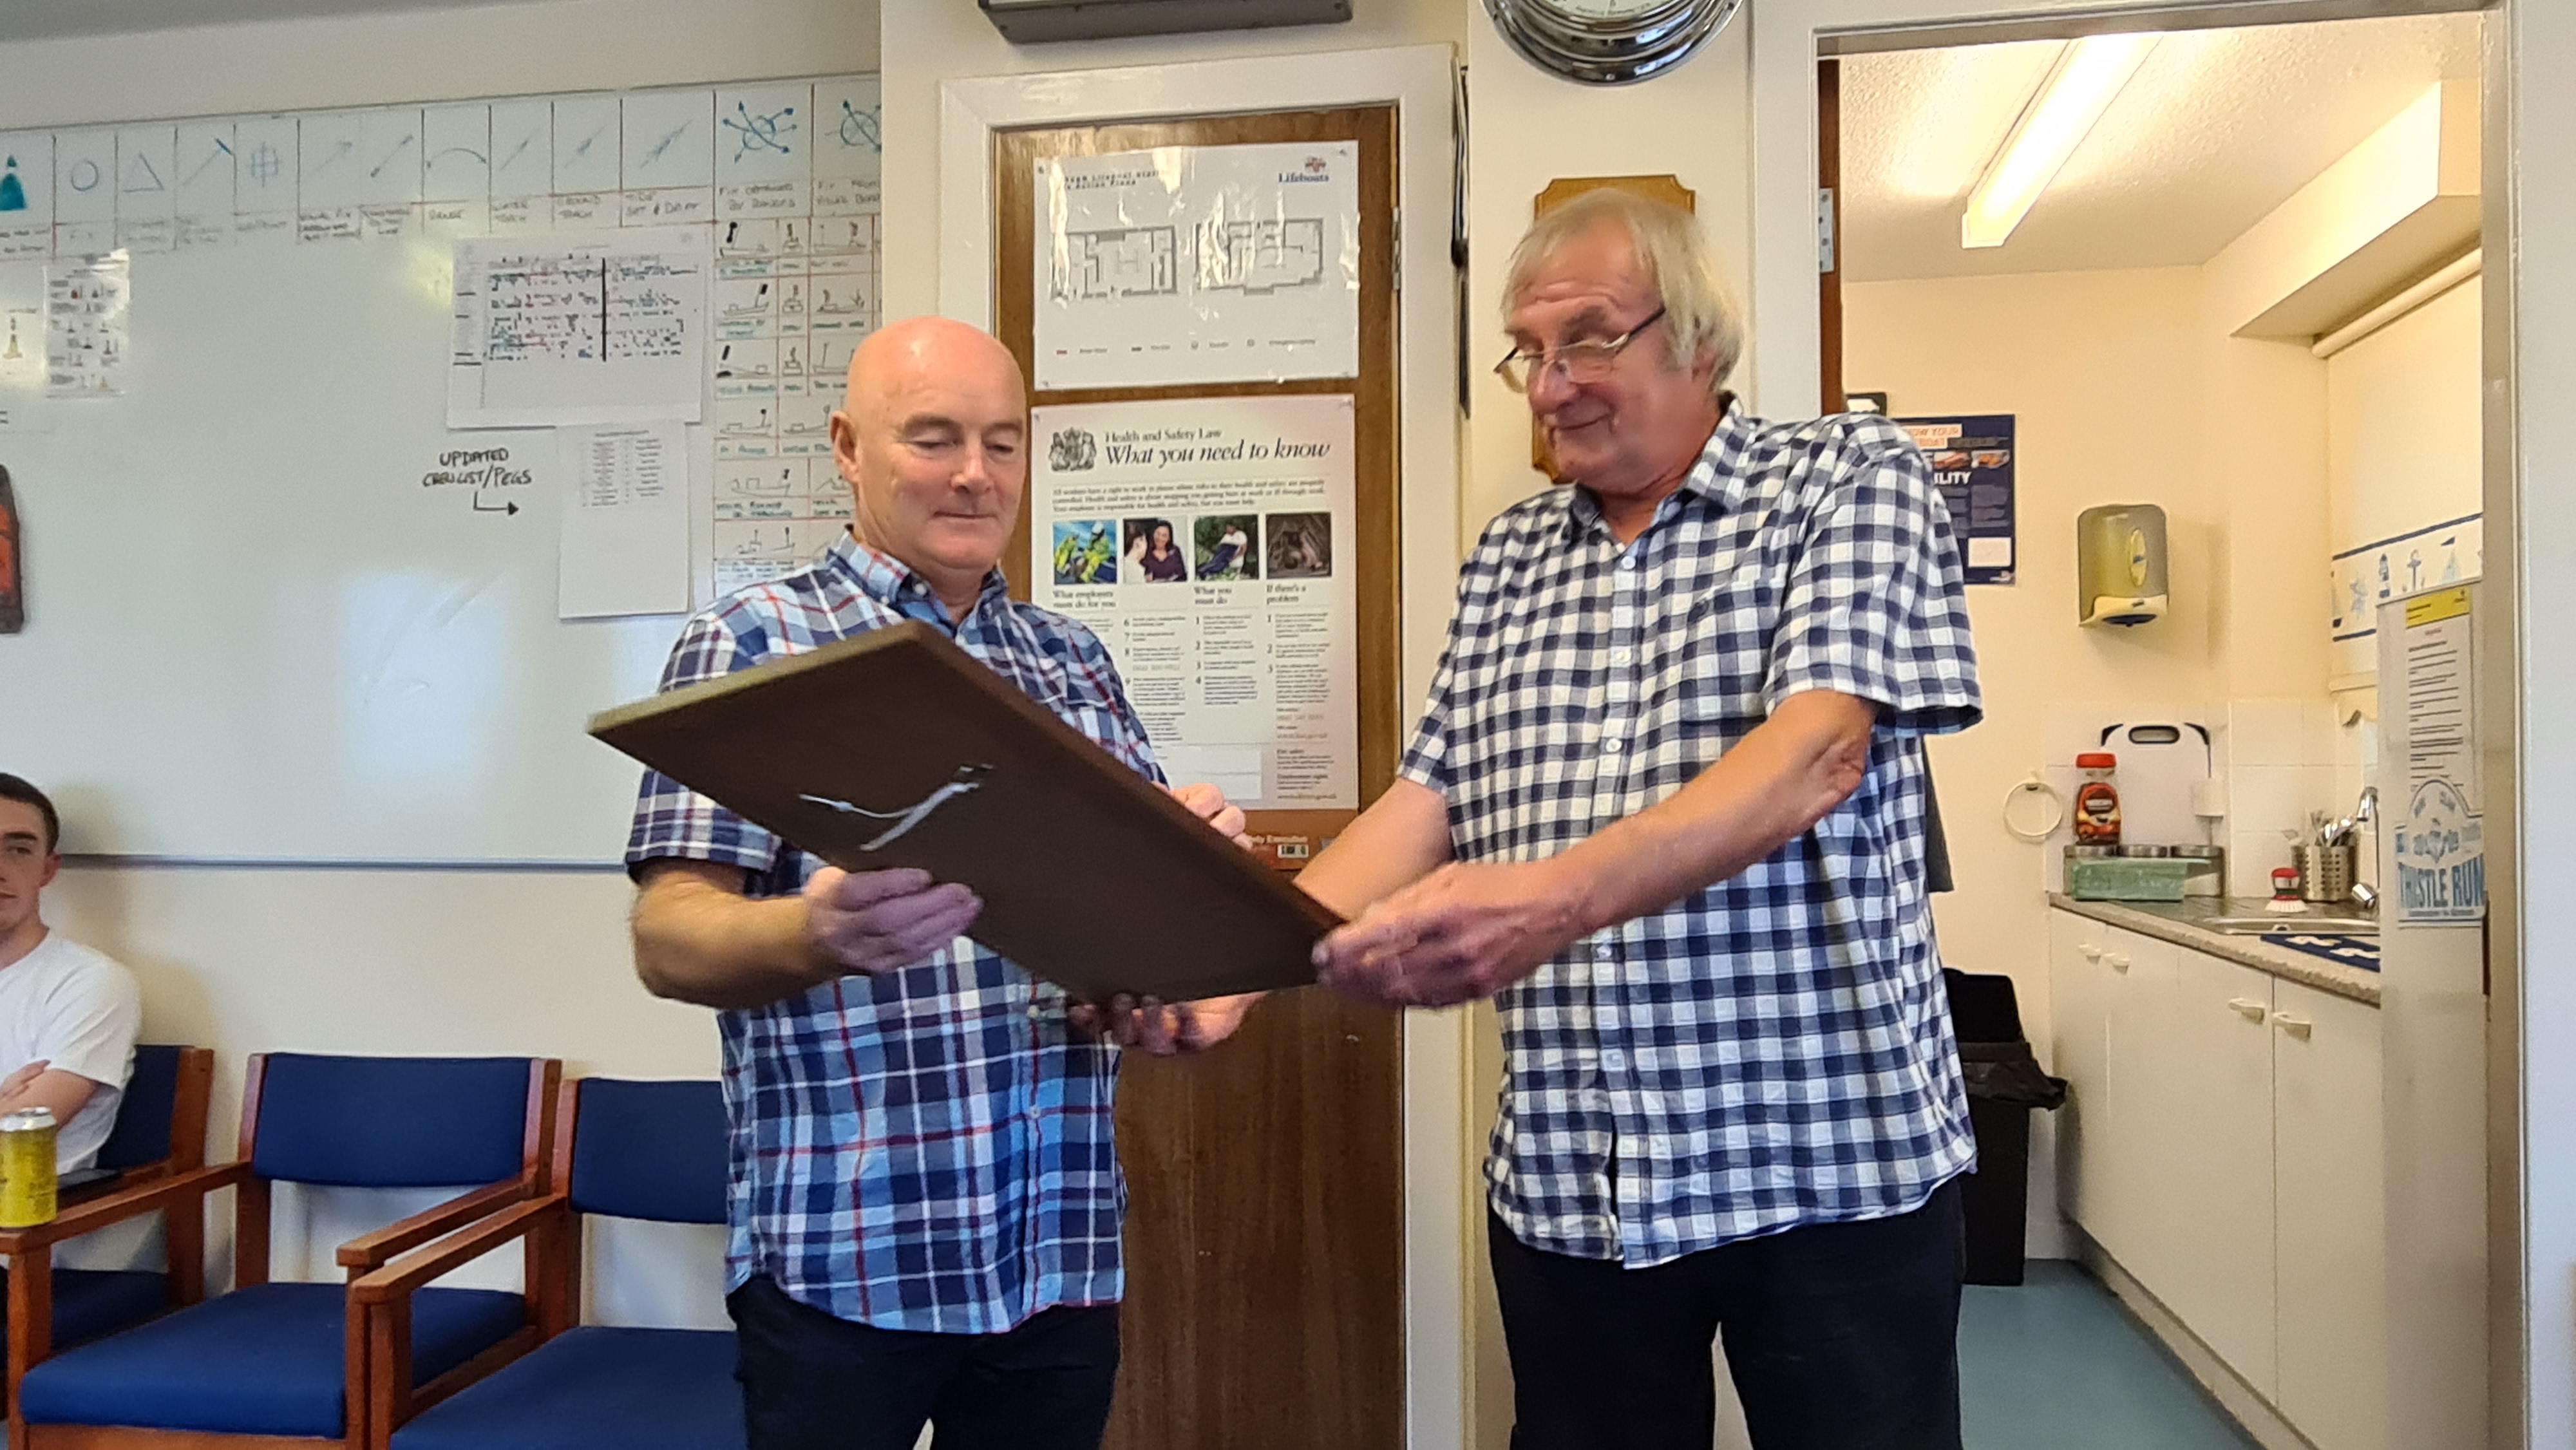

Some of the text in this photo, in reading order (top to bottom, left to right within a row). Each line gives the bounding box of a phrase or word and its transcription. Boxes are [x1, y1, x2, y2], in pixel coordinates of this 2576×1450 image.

[1278, 173, 1329, 182] Lifeboats
[1105, 428, 1222, 442] Health and Safety Law
[439, 447, 509, 467] UPDATED
[1106, 437, 1331, 469] What you need to know
[1218, 588, 1233, 598] you
[1274, 585, 1300, 593] there's
[1266, 595, 1300, 605] problem
